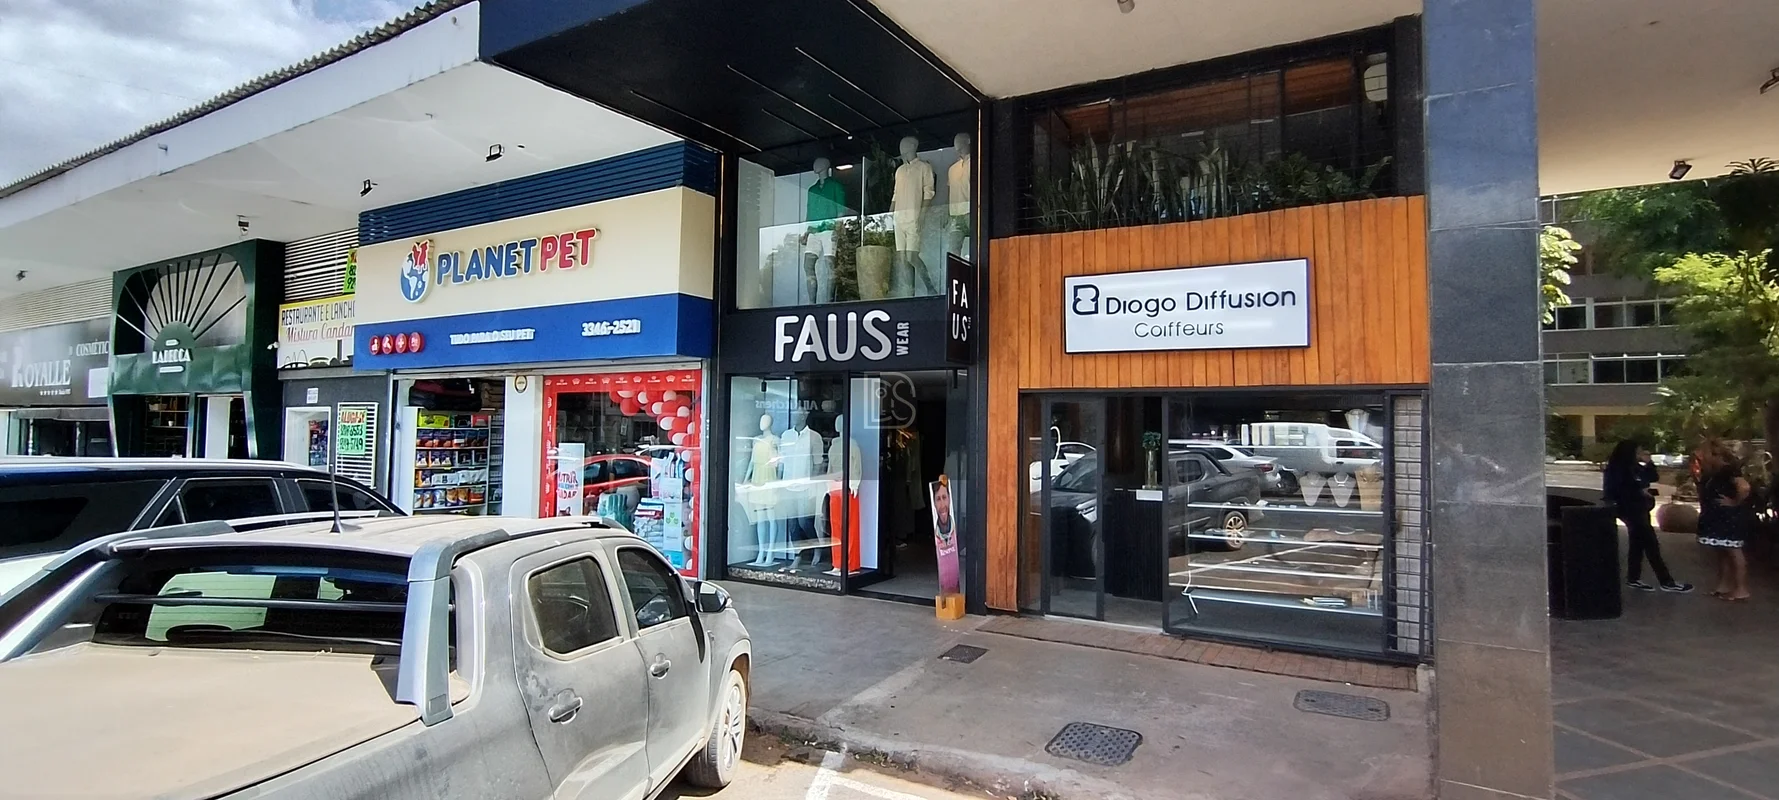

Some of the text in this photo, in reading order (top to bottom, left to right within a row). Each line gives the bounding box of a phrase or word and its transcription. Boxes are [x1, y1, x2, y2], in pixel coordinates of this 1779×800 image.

[281, 304, 324, 326] RESTAURANTE
[325, 304, 330, 321] E
[1106, 290, 1296, 317] Diogo Diffusion
[287, 326, 318, 343] Mistura
[774, 309, 892, 362] FAUS
[896, 321, 910, 356] WEAR
[1134, 321, 1224, 338] Coiffeurs
[12, 346, 71, 388] ROYALLE
